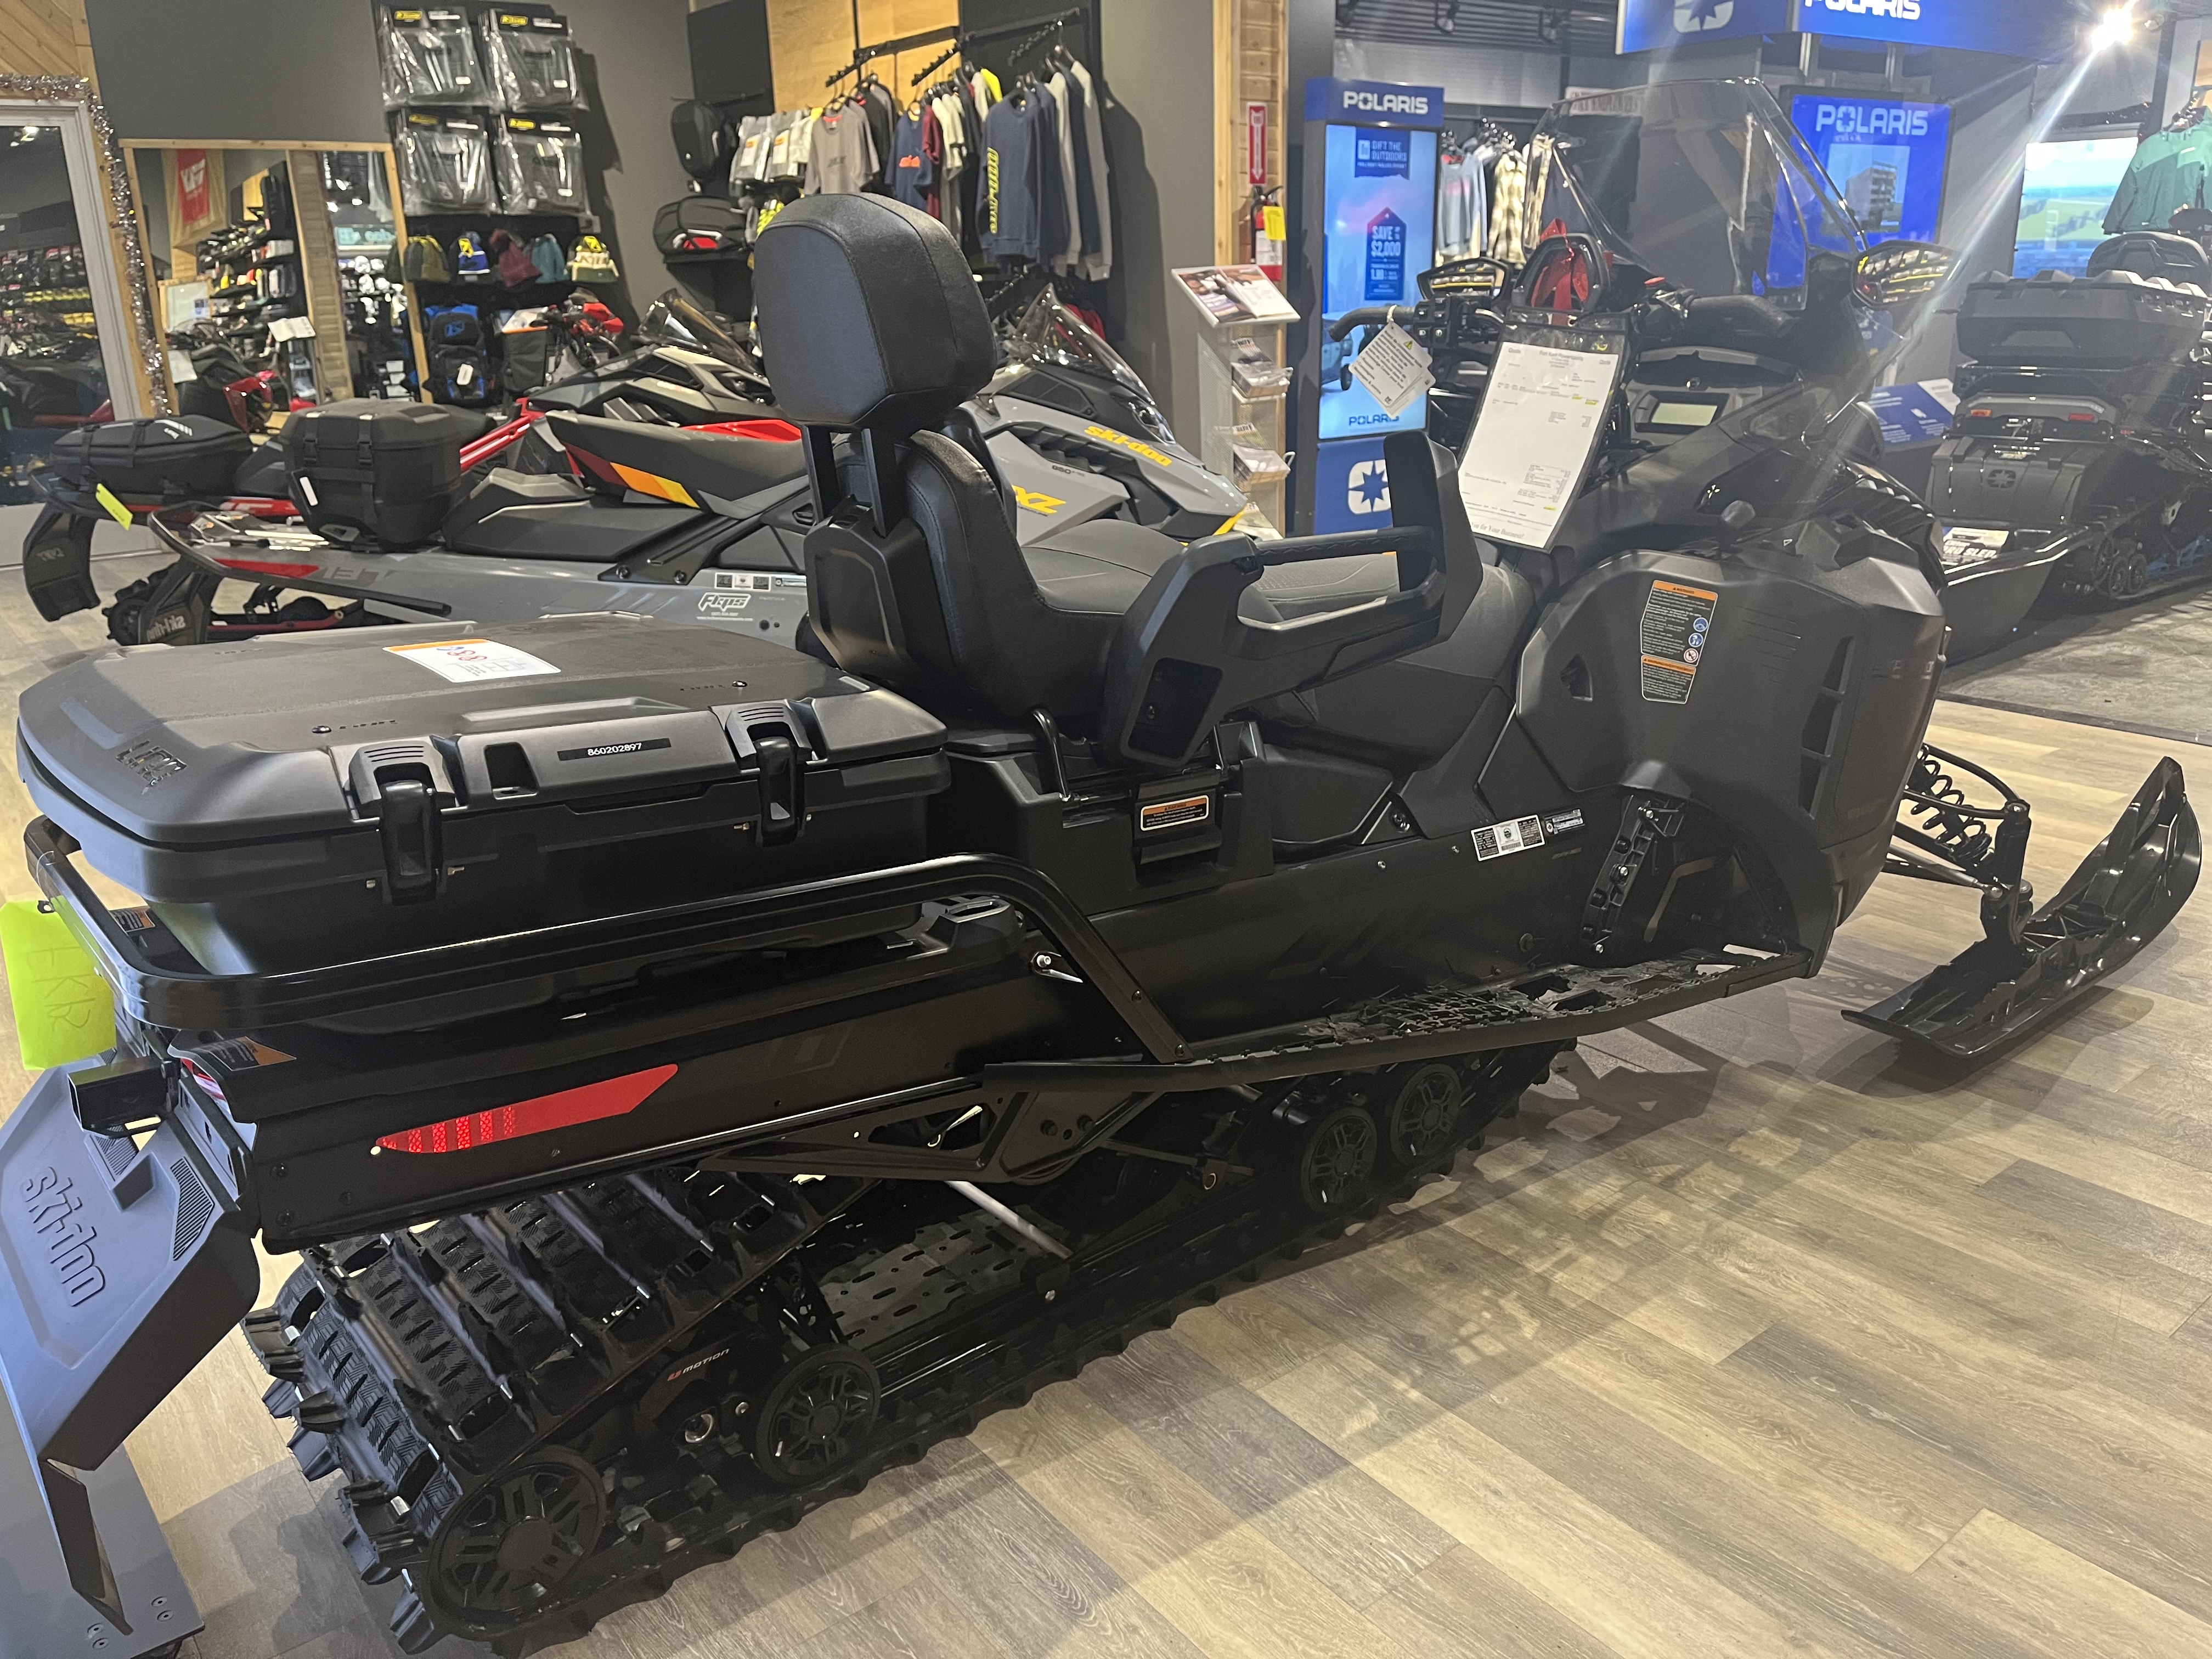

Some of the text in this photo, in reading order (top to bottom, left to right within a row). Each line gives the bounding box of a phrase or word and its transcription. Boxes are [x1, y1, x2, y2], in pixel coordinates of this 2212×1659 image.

[1804, 0, 1921, 20] LARIS
[1343, 91, 1429, 115] POLARIS
[1815, 104, 1929, 136] POLARIS
[1348, 413, 1400, 426] POLAR
[1084, 426, 1172, 466] ski-doo
[587, 742, 642, 757] 860202897
[19, 1166, 106, 1307] ski-doo
